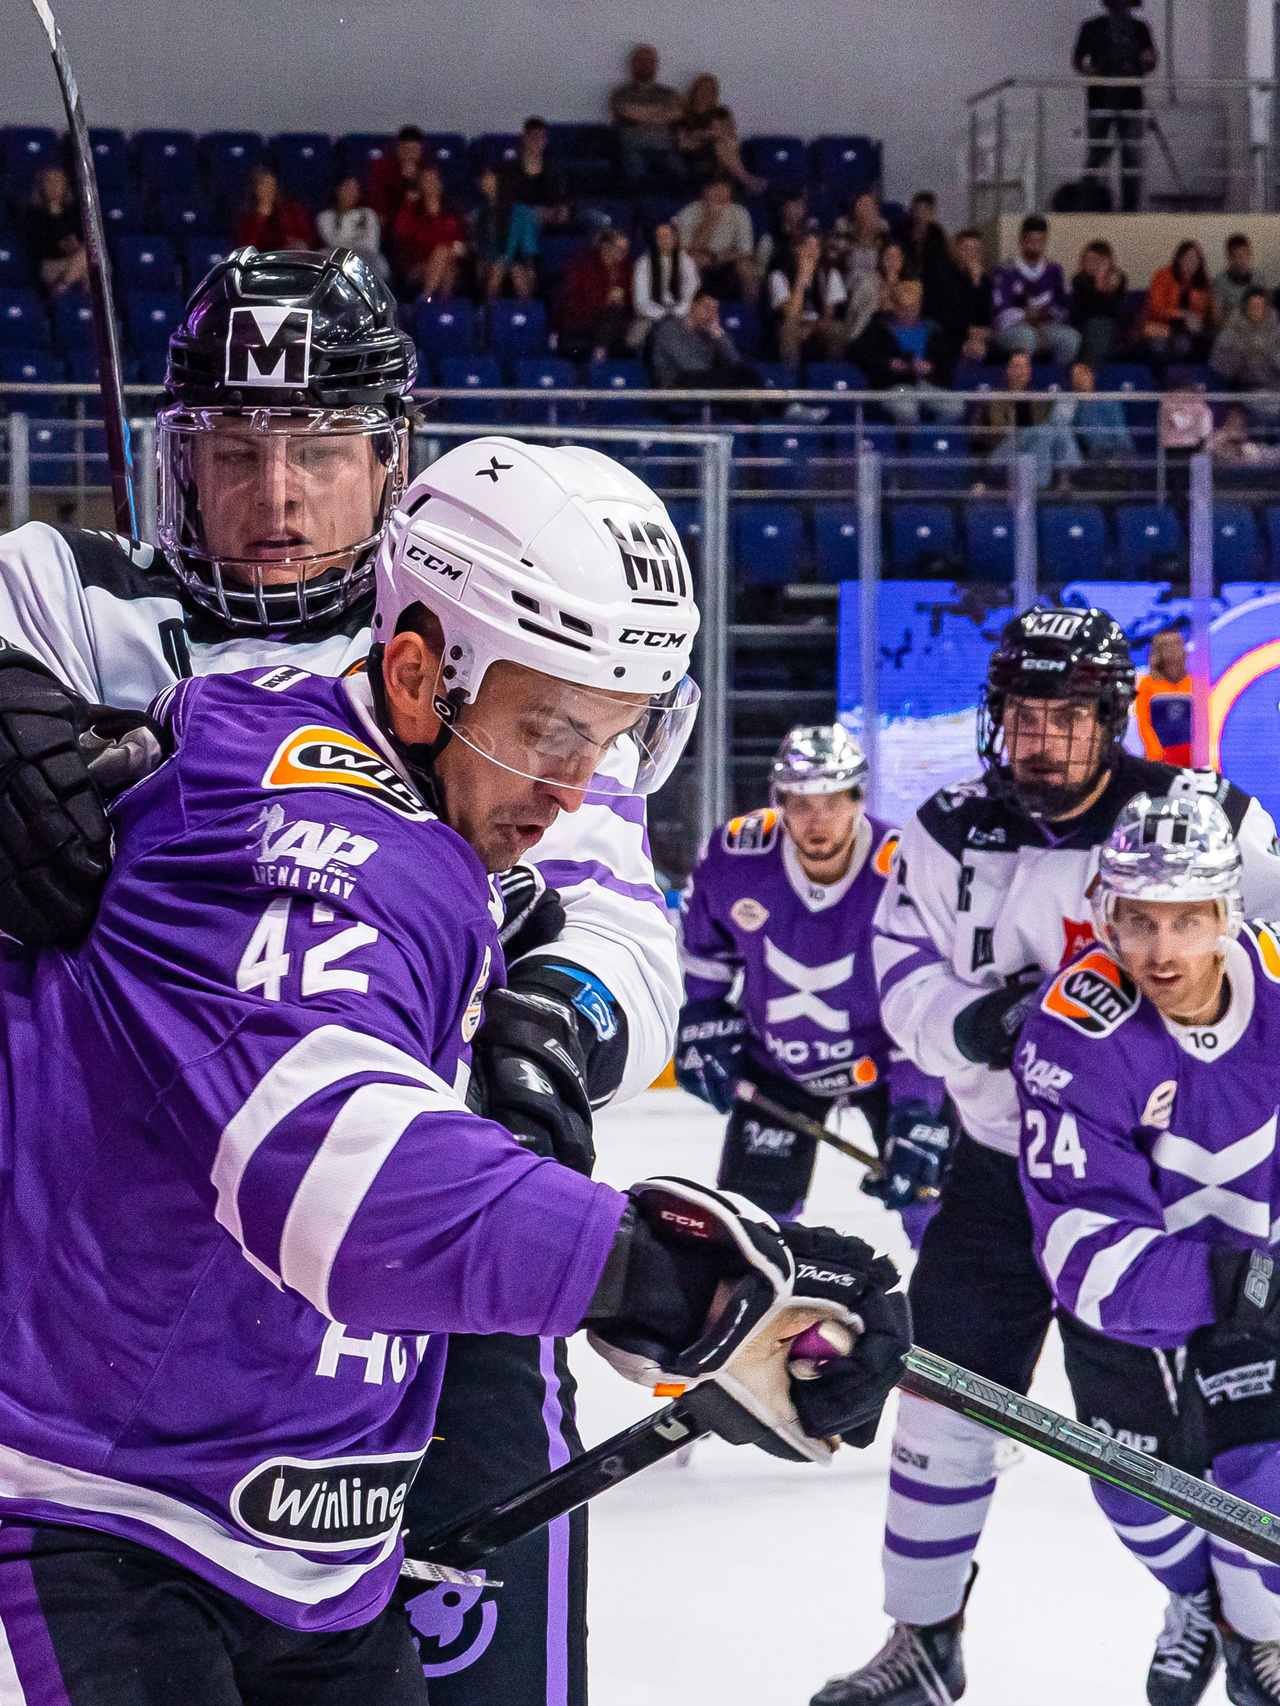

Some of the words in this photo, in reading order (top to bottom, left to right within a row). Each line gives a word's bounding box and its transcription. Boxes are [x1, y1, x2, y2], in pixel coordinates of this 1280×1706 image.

[406, 544, 464, 581] CCM
[618, 628, 688, 649] CCM
[307, 871, 355, 900] PLAY
[236, 897, 379, 1002] 42
[1072, 972, 1122, 1020] Win
[1189, 1032, 1219, 1050] 10
[1025, 1109, 1087, 1179] 24
[659, 1210, 706, 1229] CCM
[796, 1263, 856, 1287] TACKS
[268, 1477, 408, 1529] Winline
[1170, 1475, 1261, 1528] TRIGGER
